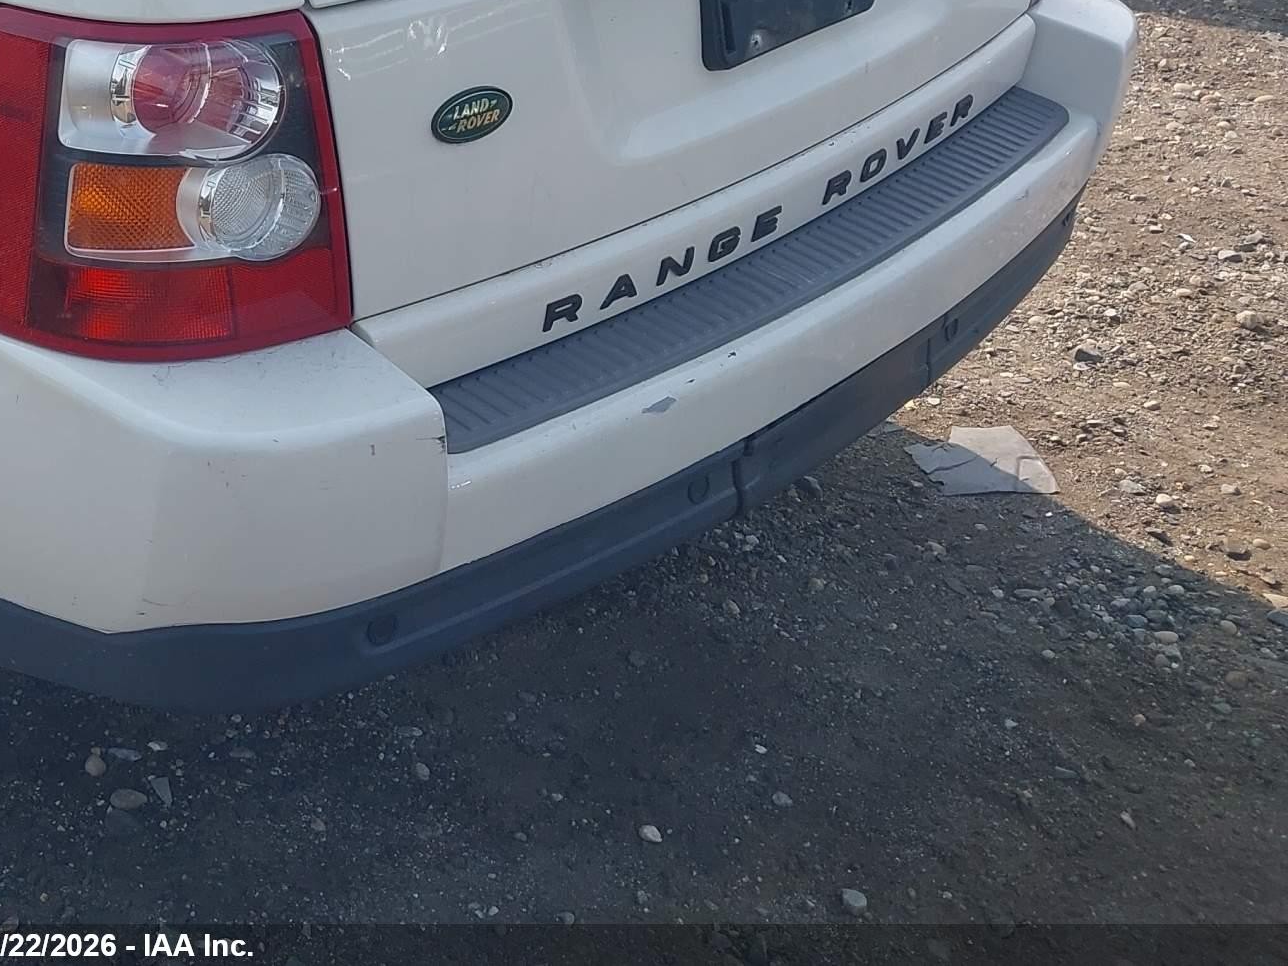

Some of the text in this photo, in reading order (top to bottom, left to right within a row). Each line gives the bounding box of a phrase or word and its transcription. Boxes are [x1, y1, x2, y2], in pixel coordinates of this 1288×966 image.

[453, 97, 490, 120] LAND
[456, 109, 500, 133] ROVER
[542, 94, 974, 333] RANGE ROVER
